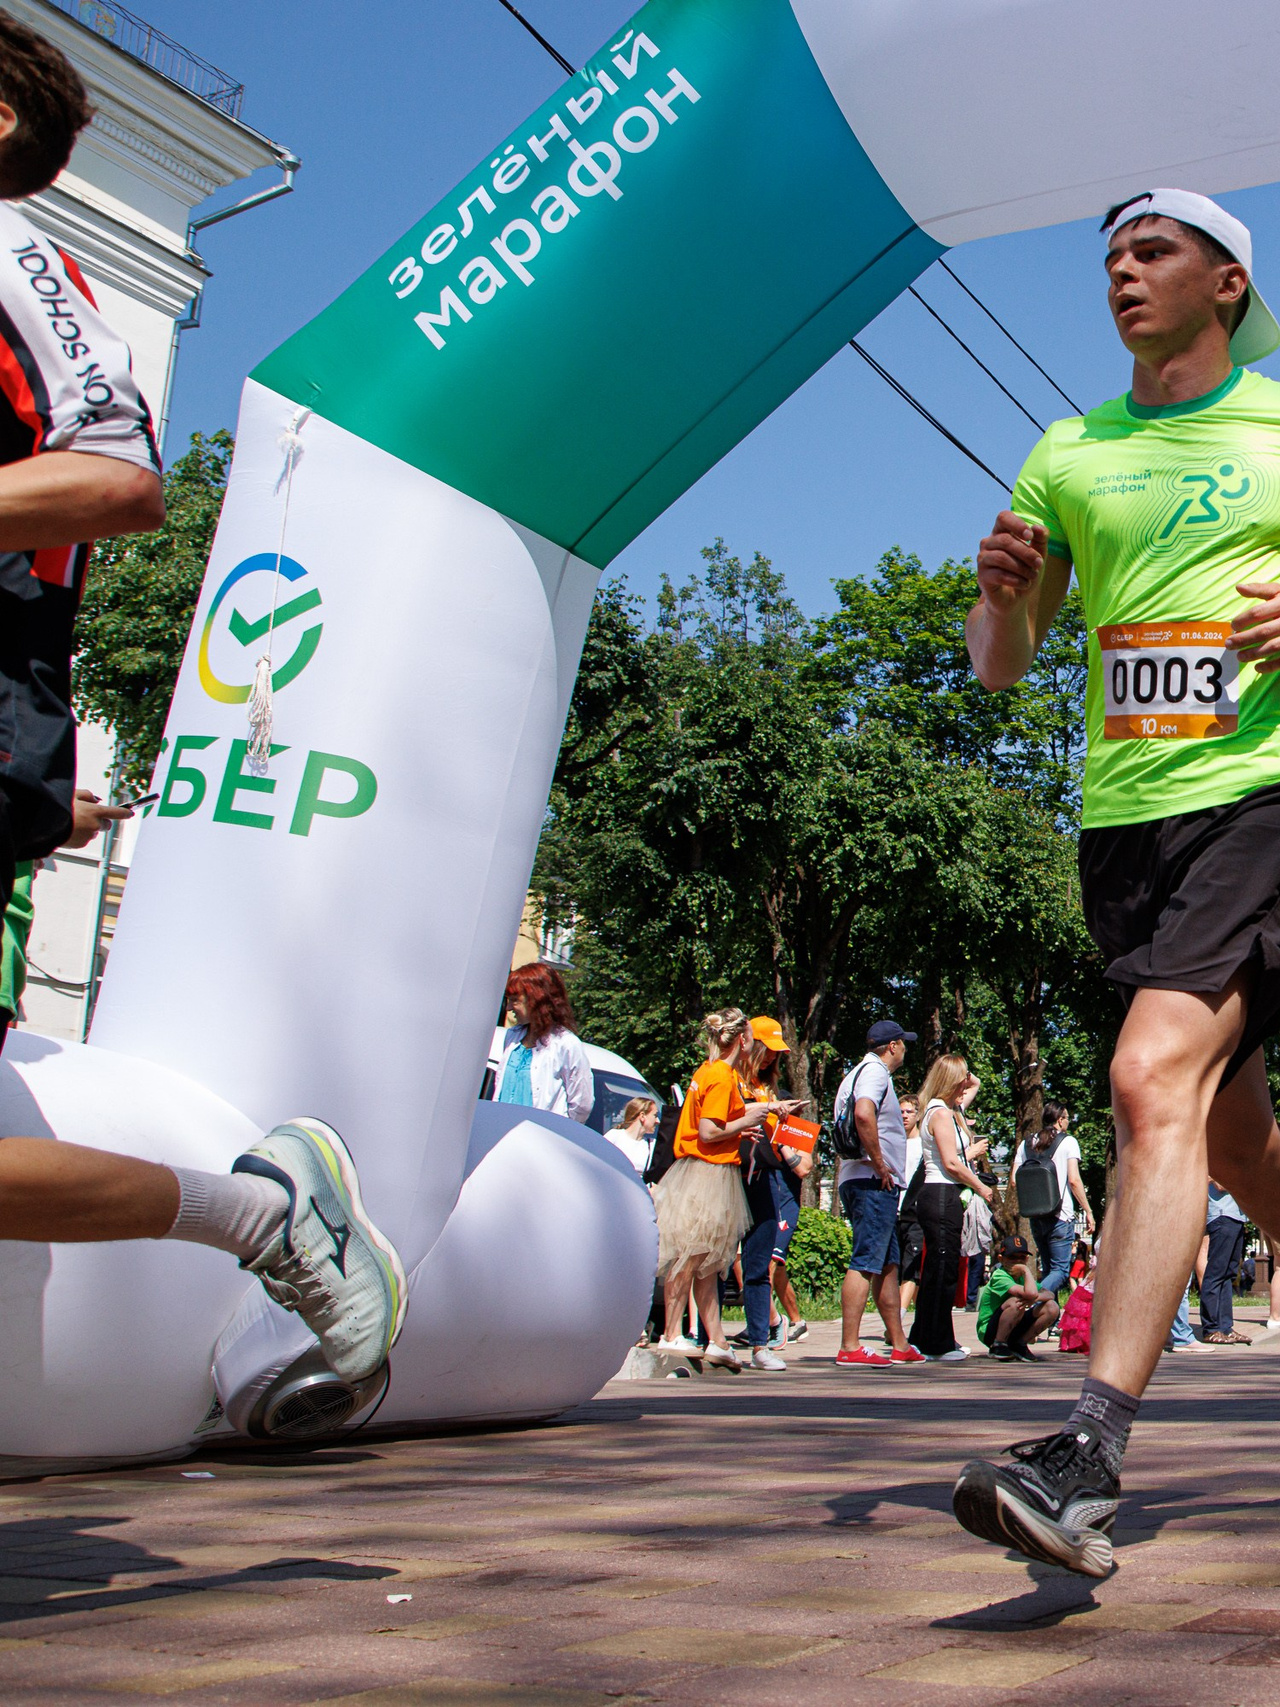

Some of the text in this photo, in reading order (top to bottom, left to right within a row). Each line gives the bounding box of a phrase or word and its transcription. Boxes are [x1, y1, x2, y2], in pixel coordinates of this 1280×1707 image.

[388, 29, 661, 299] зелёный
[413, 67, 702, 350] марафон
[11, 236, 90, 361] SCHOOL
[1087, 482, 1146, 498] марафон
[1094, 468, 1152, 485] зелёный
[1180, 631, 1223, 641] 01.06.2024
[1112, 656, 1223, 705] 0003
[1140, 717, 1157, 735] 10
[143, 734, 378, 838] БЕР
